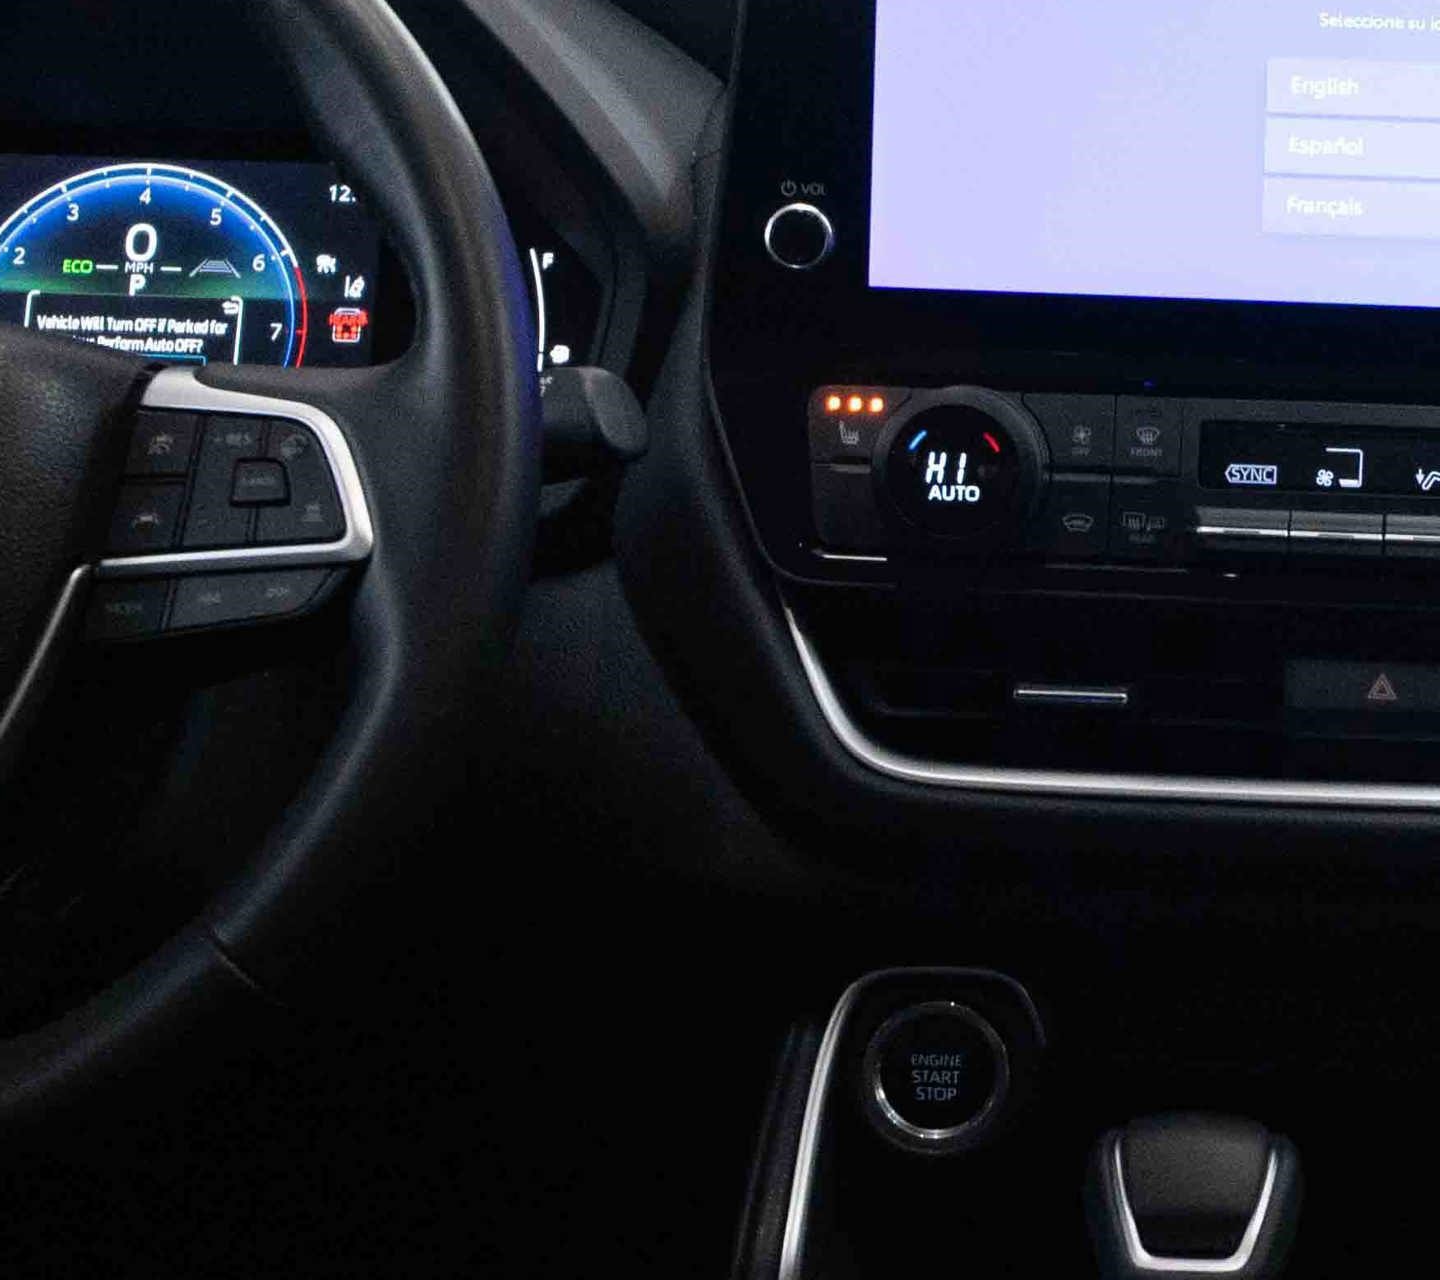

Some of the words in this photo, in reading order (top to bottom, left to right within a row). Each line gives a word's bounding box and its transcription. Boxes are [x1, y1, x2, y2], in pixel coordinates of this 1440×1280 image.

[1319, 12, 1404, 31] Seleccione
[1408, 16, 1426, 31] su
[1290, 75, 1359, 100] English
[1288, 135, 1364, 158] Español
[139, 187, 152, 205] 4
[66, 204, 80, 222] 3
[210, 207, 222, 226] 5
[1286, 194, 1364, 220] Français
[124, 222, 158, 262] 0
[12, 247, 25, 265] 2
[252, 253, 266, 272] 6
[541, 251, 555, 271] F
[62, 259, 93, 275] ECO
[124, 261, 155, 274] MPH
[128, 274, 146, 297] P
[37, 314, 80, 330] Vehicle
[81, 316, 104, 331] Will
[106, 316, 133, 332] Turn
[134, 317, 158, 333] OFF
[168, 319, 210, 335] Parked
[210, 320, 228, 335] for
[270, 322, 283, 342] 7
[145, 337, 175, 353] Auto
[175, 338, 204, 354] OFF?
[924, 452, 968, 486] HI
[1230, 465, 1276, 484] SYNC
[927, 484, 981, 502] AUTO
[911, 1053, 962, 1068] ENGINE
[911, 1069, 960, 1085] START
[915, 1086, 957, 1101] STOP
